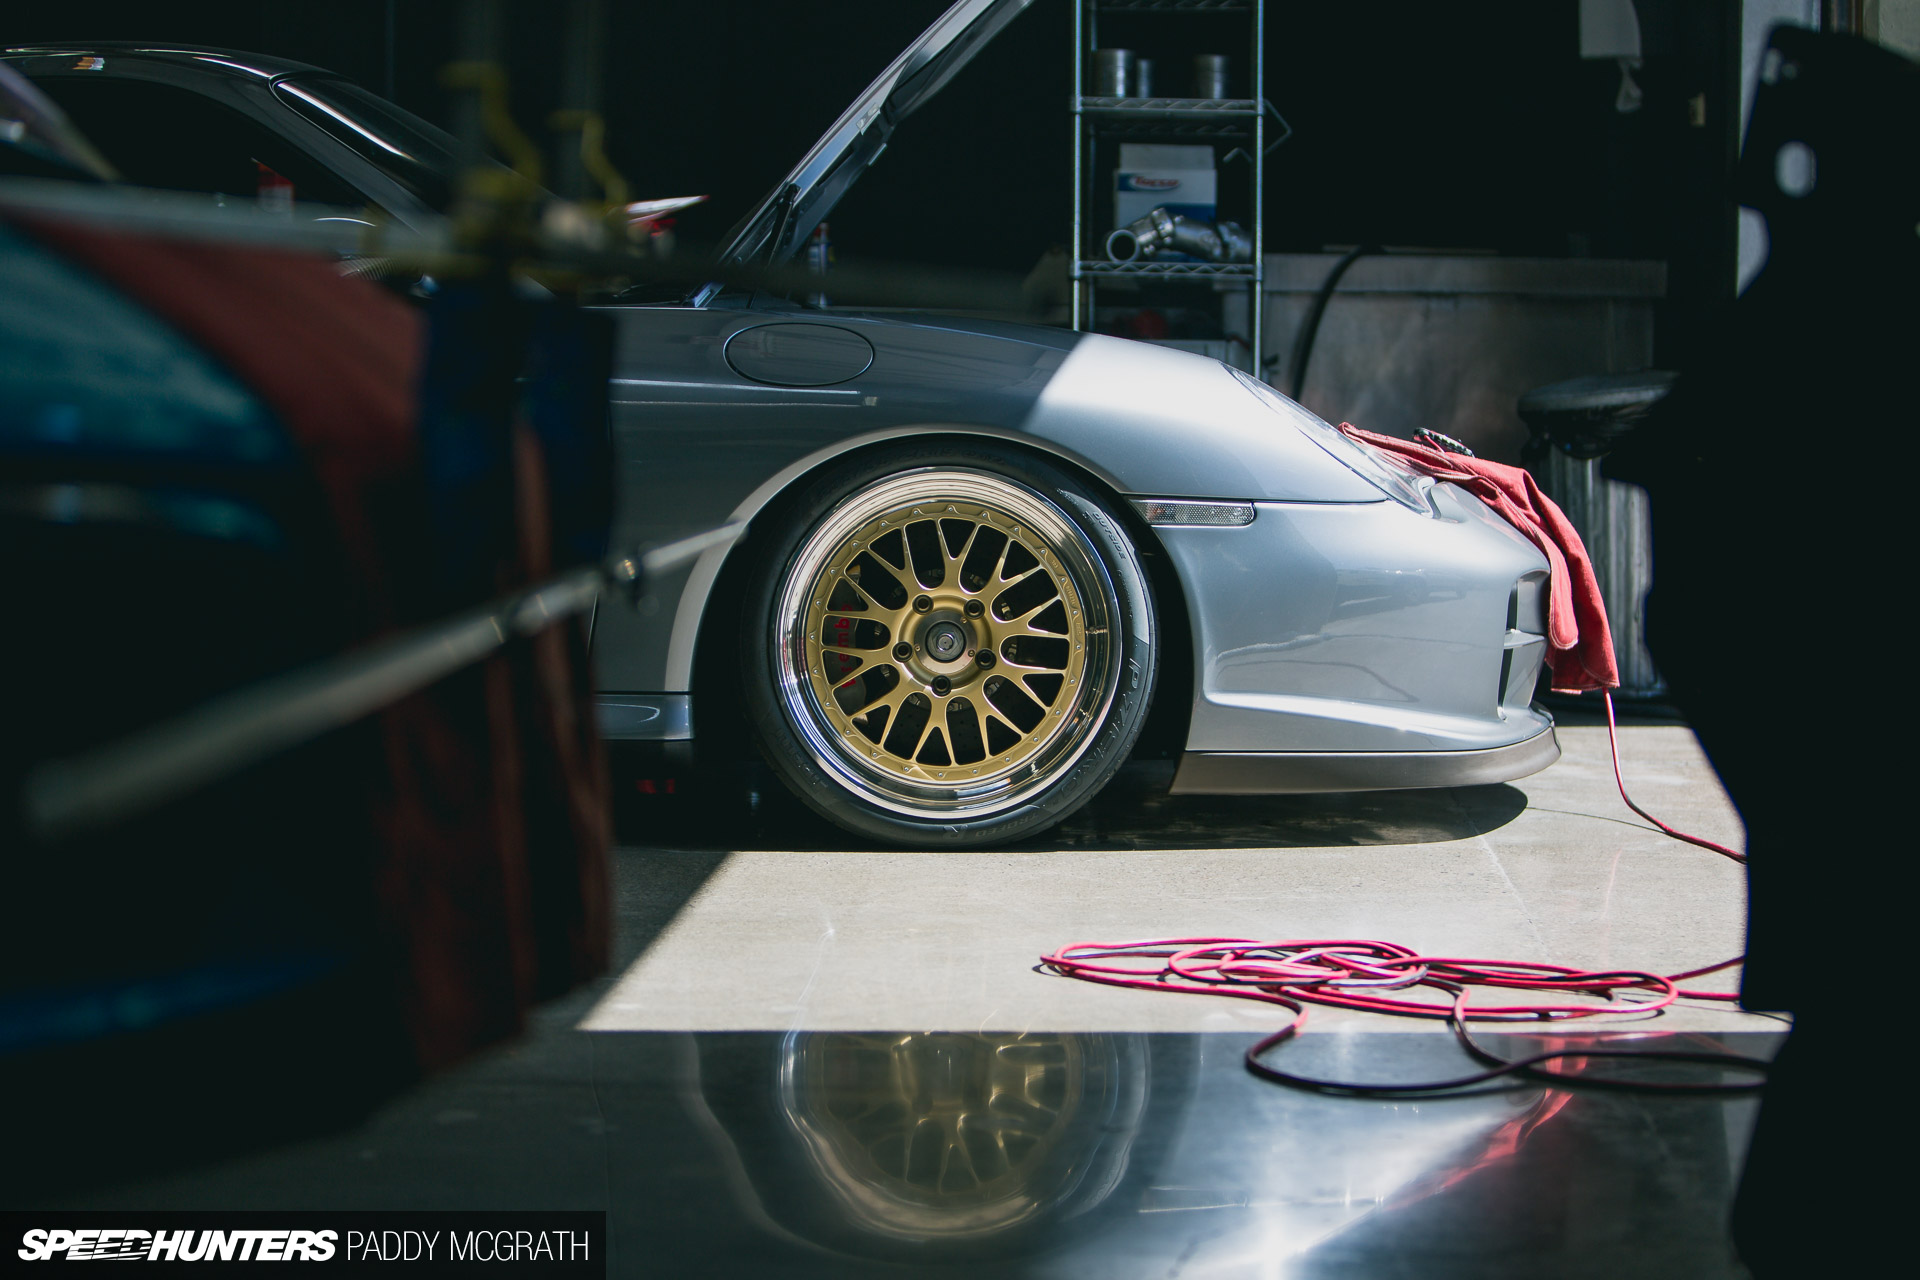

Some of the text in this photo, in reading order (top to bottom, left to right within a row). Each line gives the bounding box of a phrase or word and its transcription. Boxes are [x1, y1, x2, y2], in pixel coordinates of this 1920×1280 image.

[1092, 511, 1127, 560] OUTSIDE
[1128, 657, 1142, 689] P
[975, 811, 1039, 837] TROFEO
